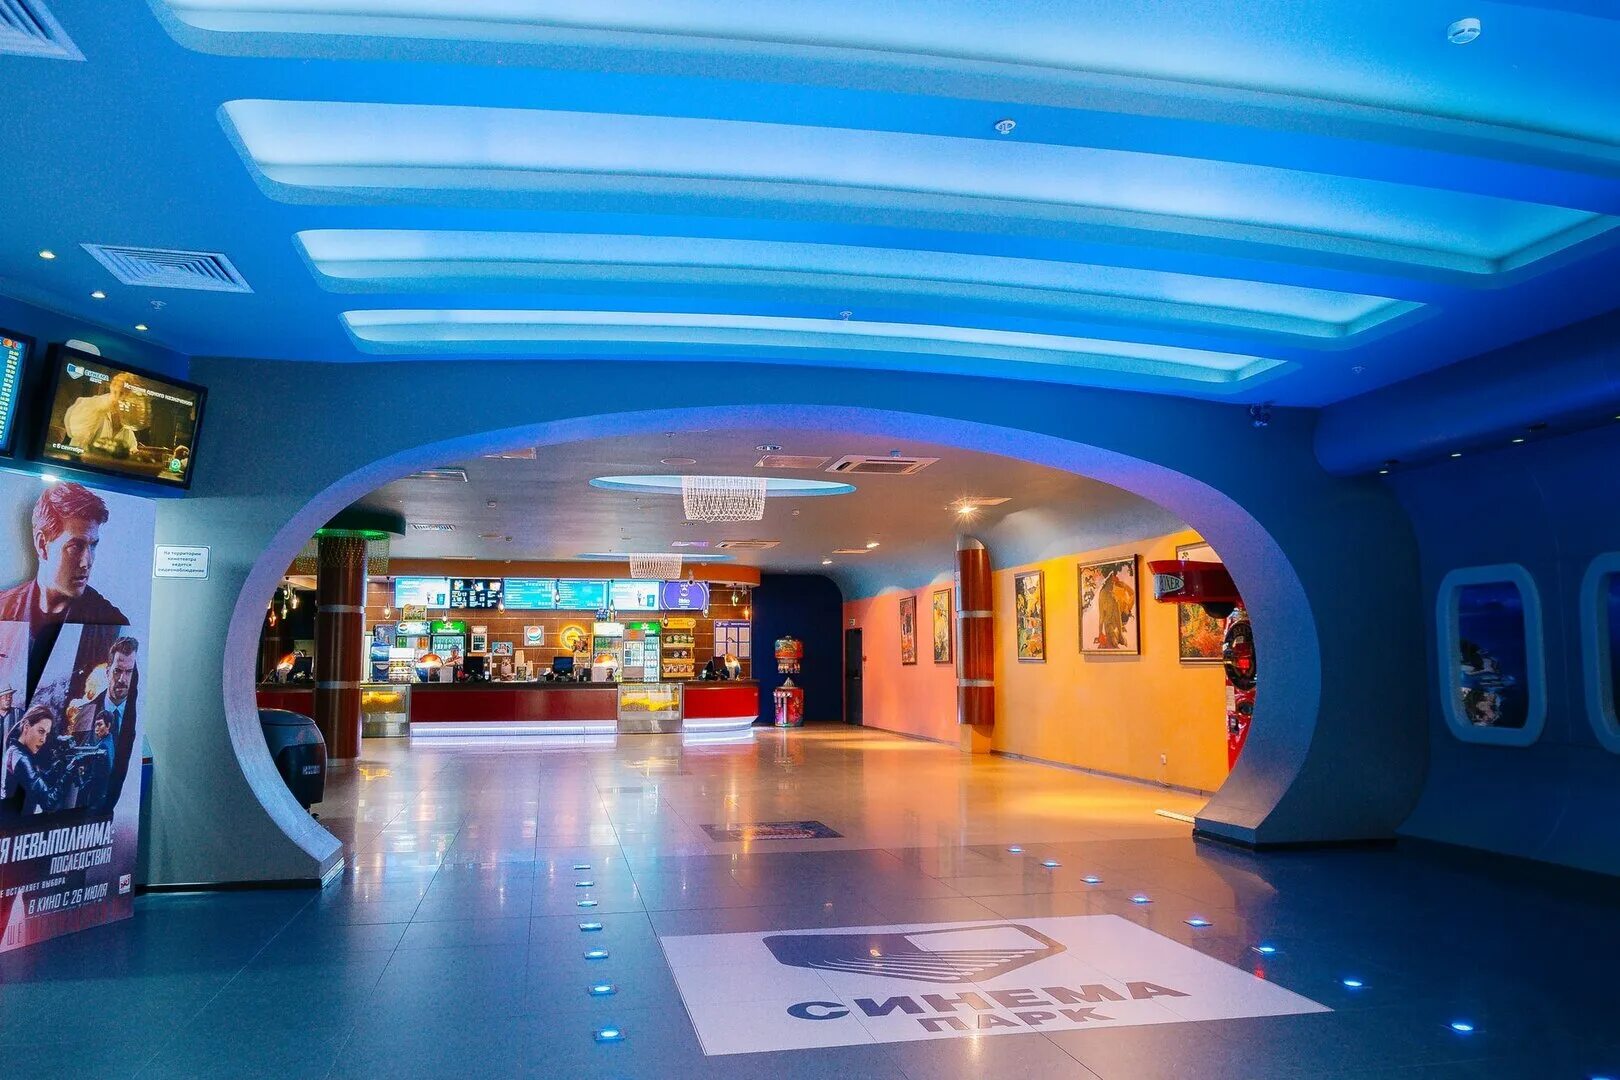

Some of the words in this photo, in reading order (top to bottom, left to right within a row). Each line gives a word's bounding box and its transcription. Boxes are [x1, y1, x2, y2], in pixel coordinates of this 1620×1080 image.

[12, 820, 114, 863] НЕВЫПОЛНИМА:
[50, 846, 113, 875] ПОСЛЕДСТВИЯ
[28, 901, 35, 915] В
[37, 891, 60, 912] КИНО
[62, 889, 70, 907] С
[71, 888, 83, 904] 26
[84, 882, 109, 902] ИЮЛЯ
[786, 981, 1192, 1020] СИНЕМА
[916, 1006, 1116, 1032] ПАРК
